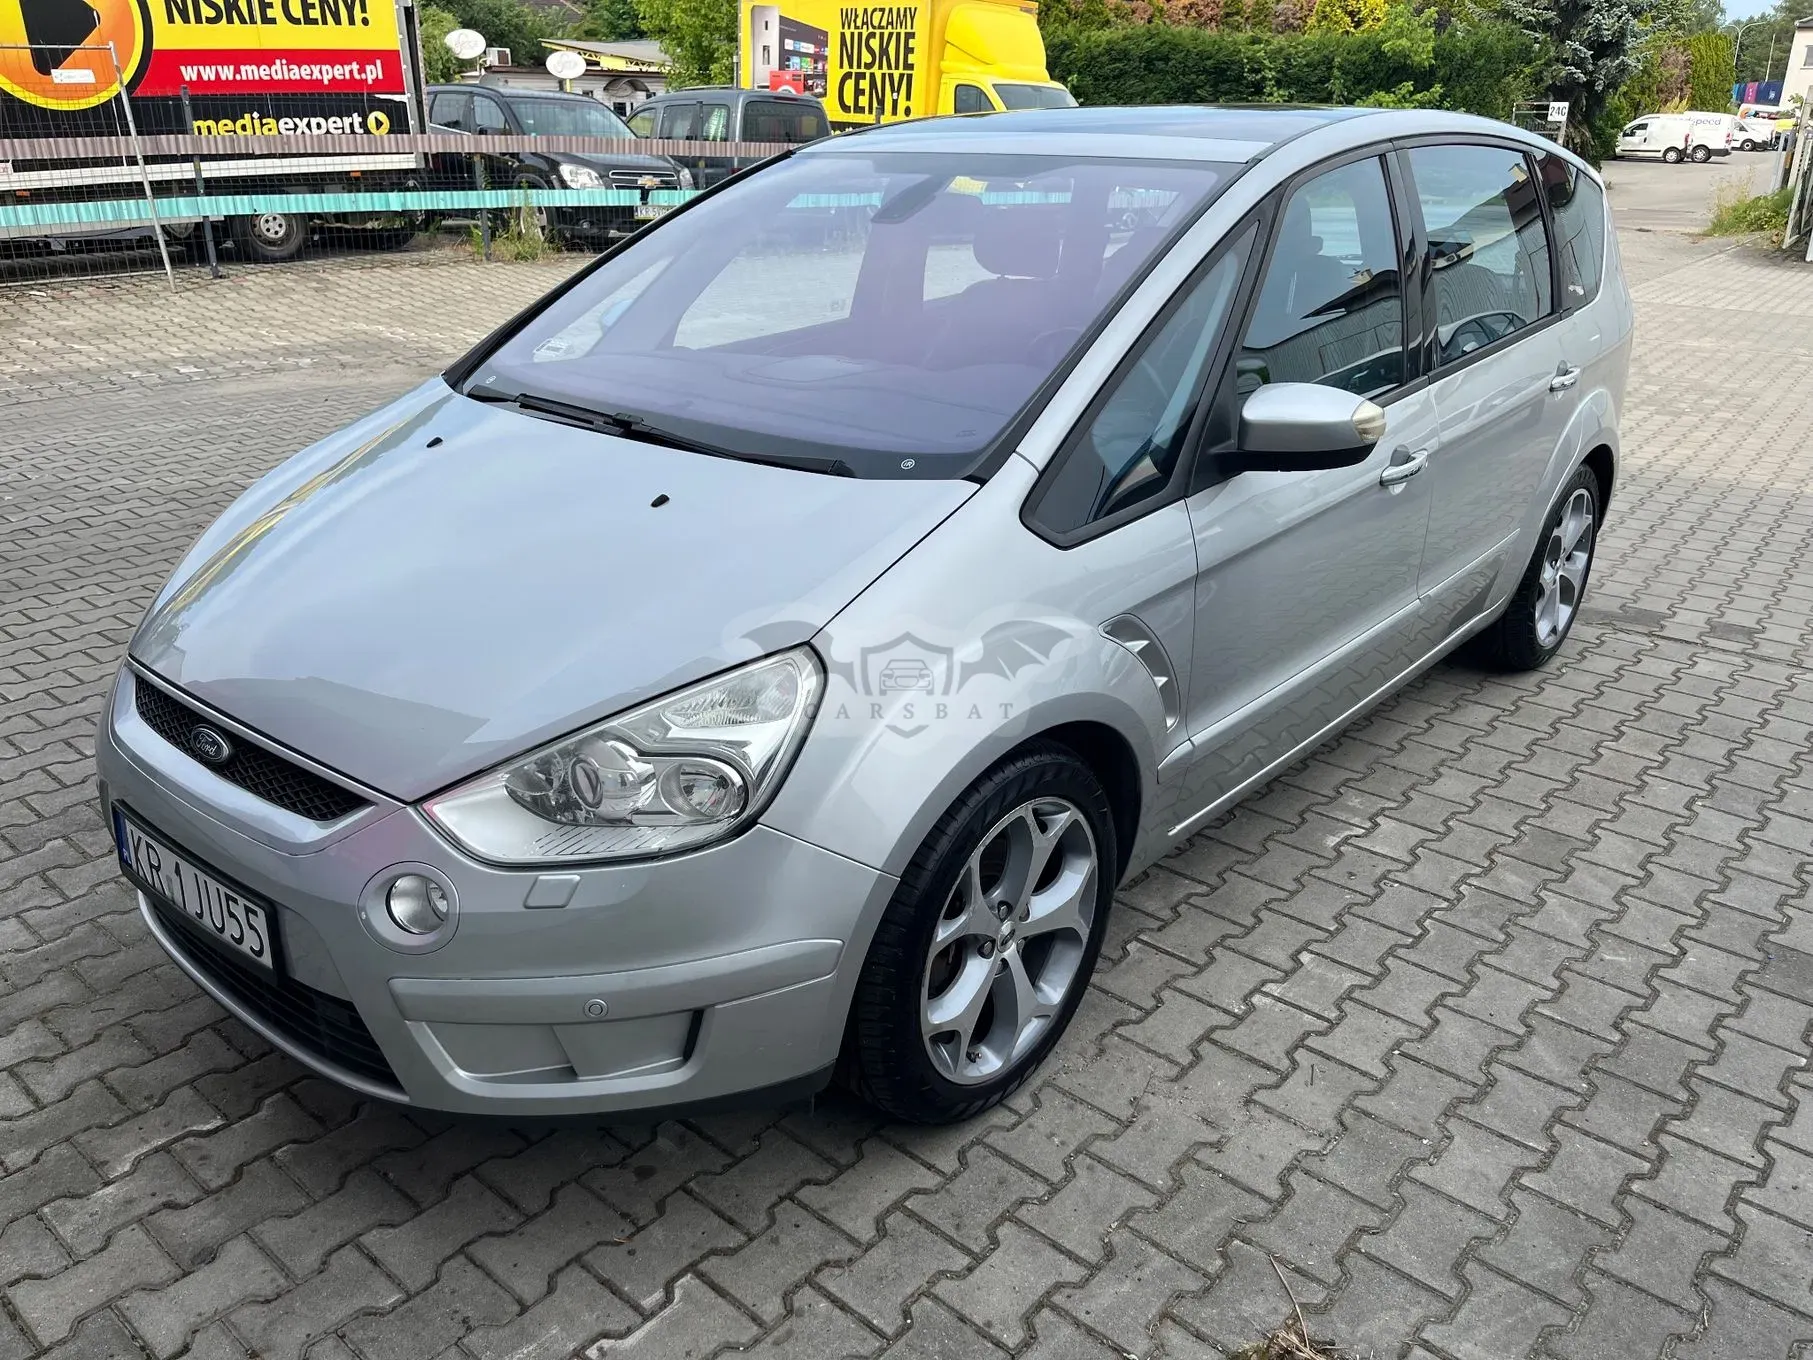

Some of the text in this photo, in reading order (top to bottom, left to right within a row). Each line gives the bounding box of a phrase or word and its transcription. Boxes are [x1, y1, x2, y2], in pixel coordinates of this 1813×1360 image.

[165, 0, 370, 27] NISKIE CENY!
[839, 7, 918, 32] WŁĄCZAMY
[839, 31, 916, 71] NISKIE
[180, 59, 383, 85] www.mediaexpert.pl
[838, 71, 914, 118] CENY!
[193, 111, 364, 136] mediaexpert
[196, 732, 218, 756] Ford
[130, 829, 265, 958] KR 1JU55
